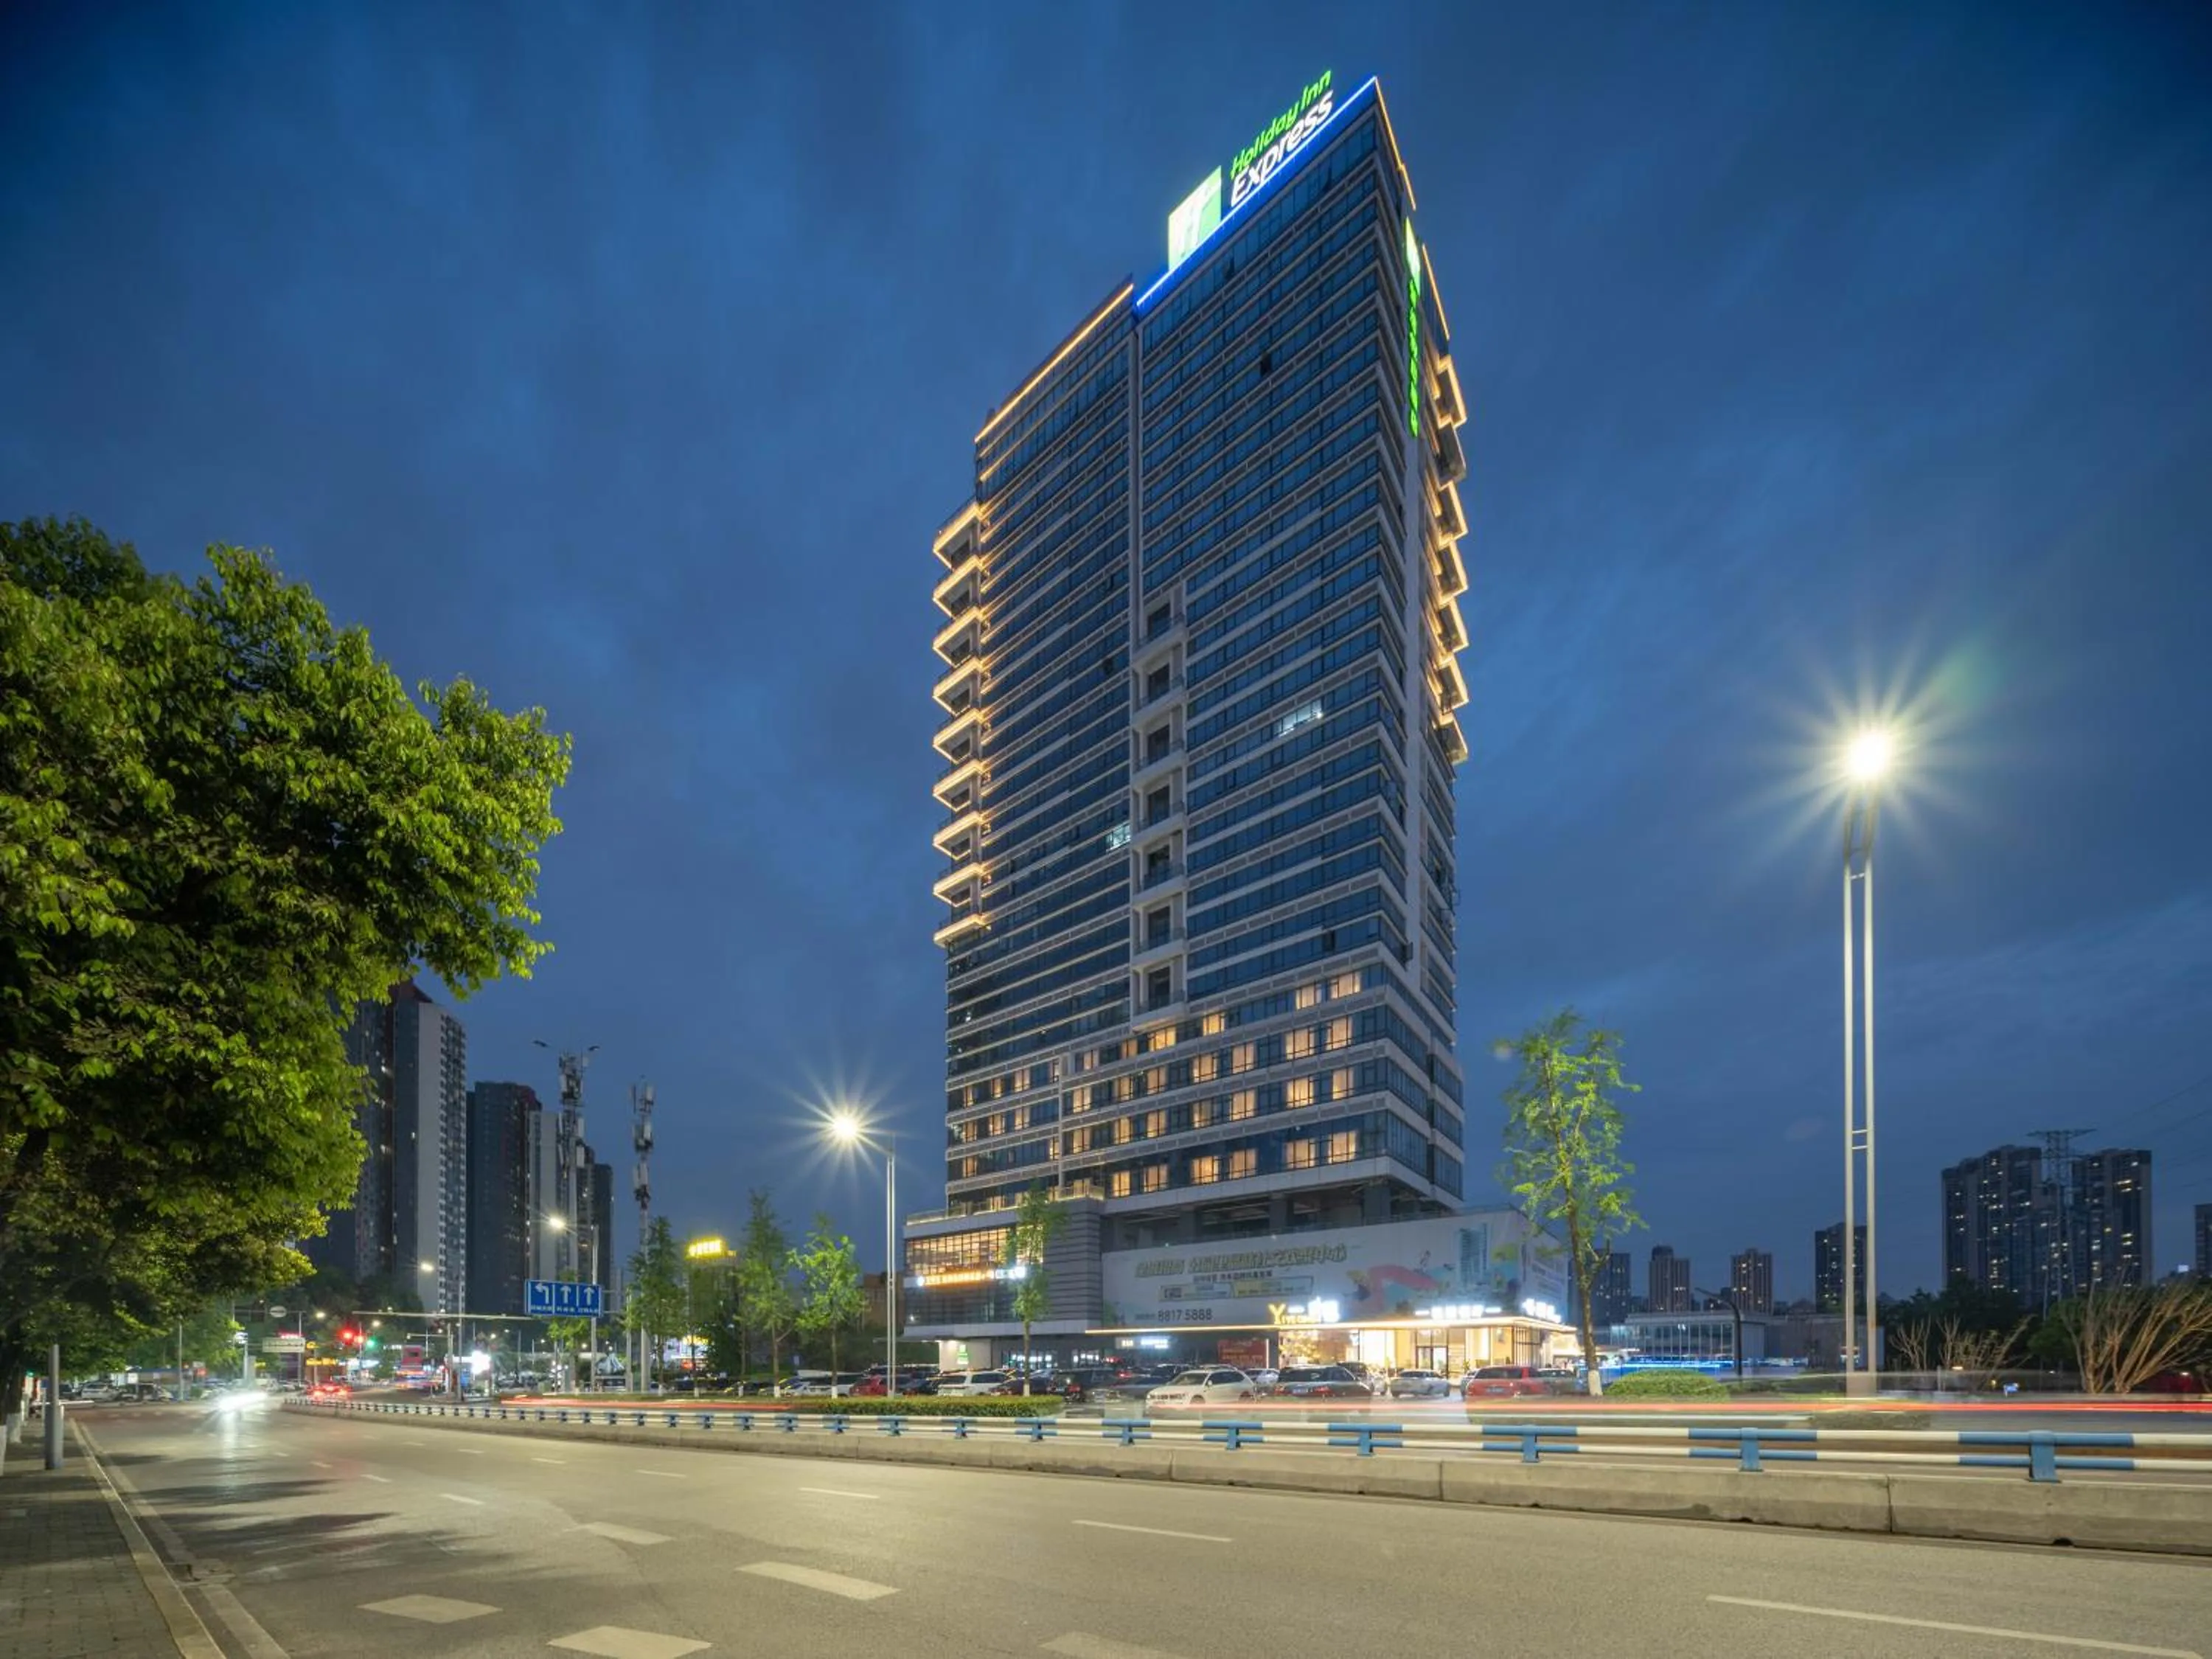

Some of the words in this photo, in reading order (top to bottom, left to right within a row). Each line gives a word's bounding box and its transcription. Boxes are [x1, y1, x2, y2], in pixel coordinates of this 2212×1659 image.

[1231, 100, 1299, 179] Holiday
[1301, 70, 1331, 111] Inn
[1231, 89, 1333, 206] Express
